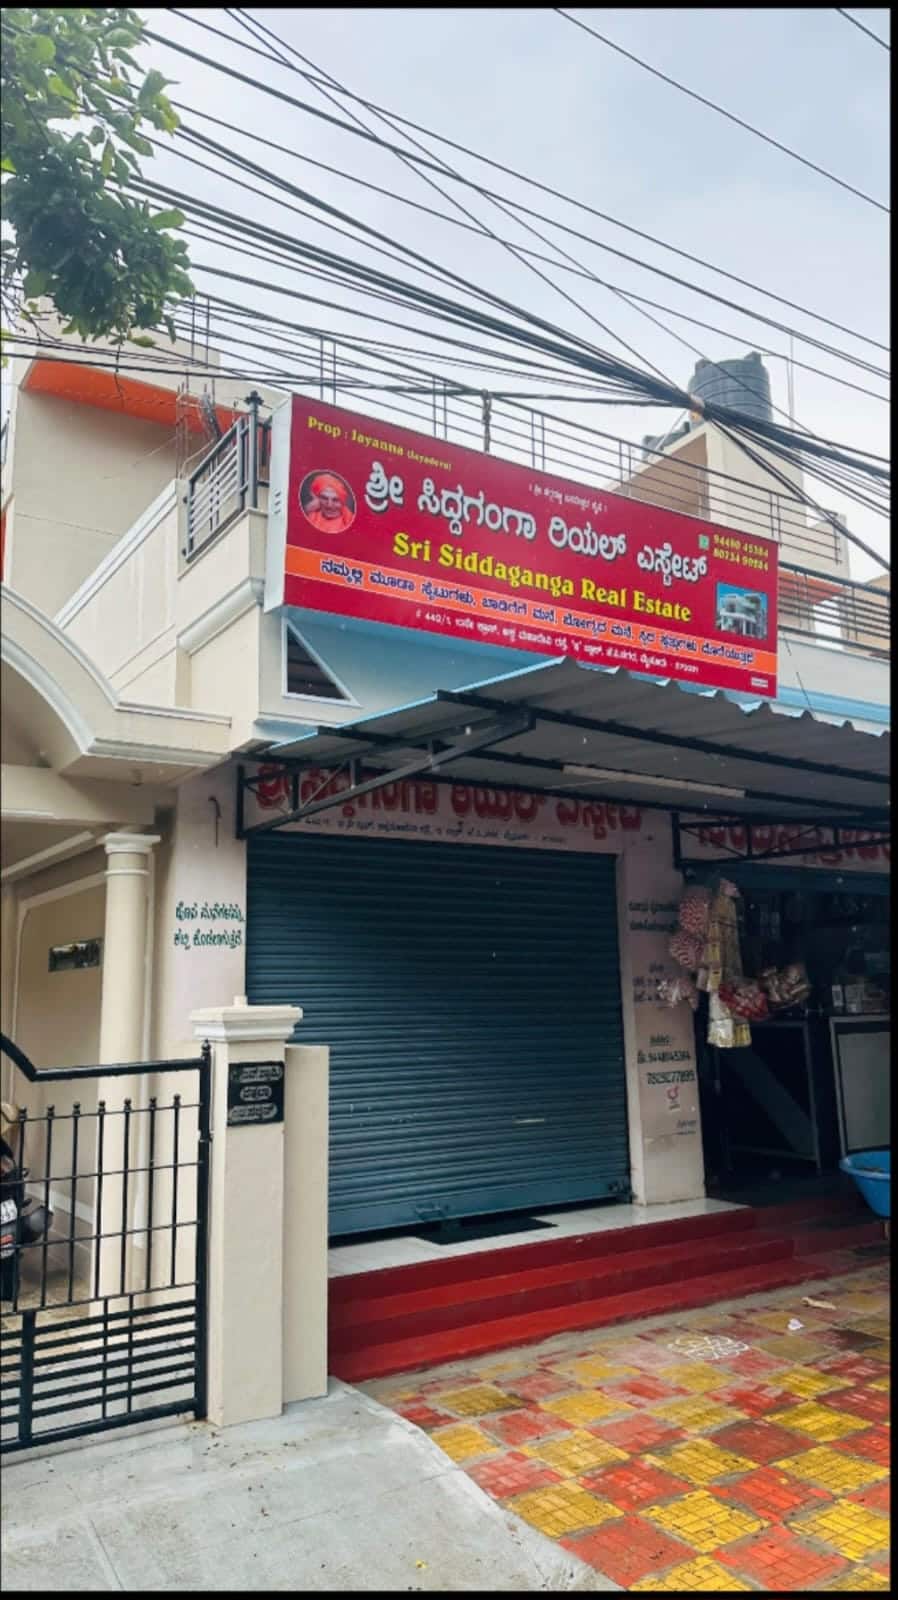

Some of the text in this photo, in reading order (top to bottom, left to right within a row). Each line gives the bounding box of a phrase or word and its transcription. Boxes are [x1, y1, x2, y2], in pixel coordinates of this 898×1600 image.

[307, 416, 341, 437] Prop
[351, 429, 404, 456] Jayanna
[364, 460, 404, 512] ಶ್ರೀ
[548, 515, 626, 561] ರಿಯಲ್
[637, 542, 707, 586] ಎಸ್ಟೇಟ್
[392, 532, 692, 621] Sri Siddaganga Real Estate
